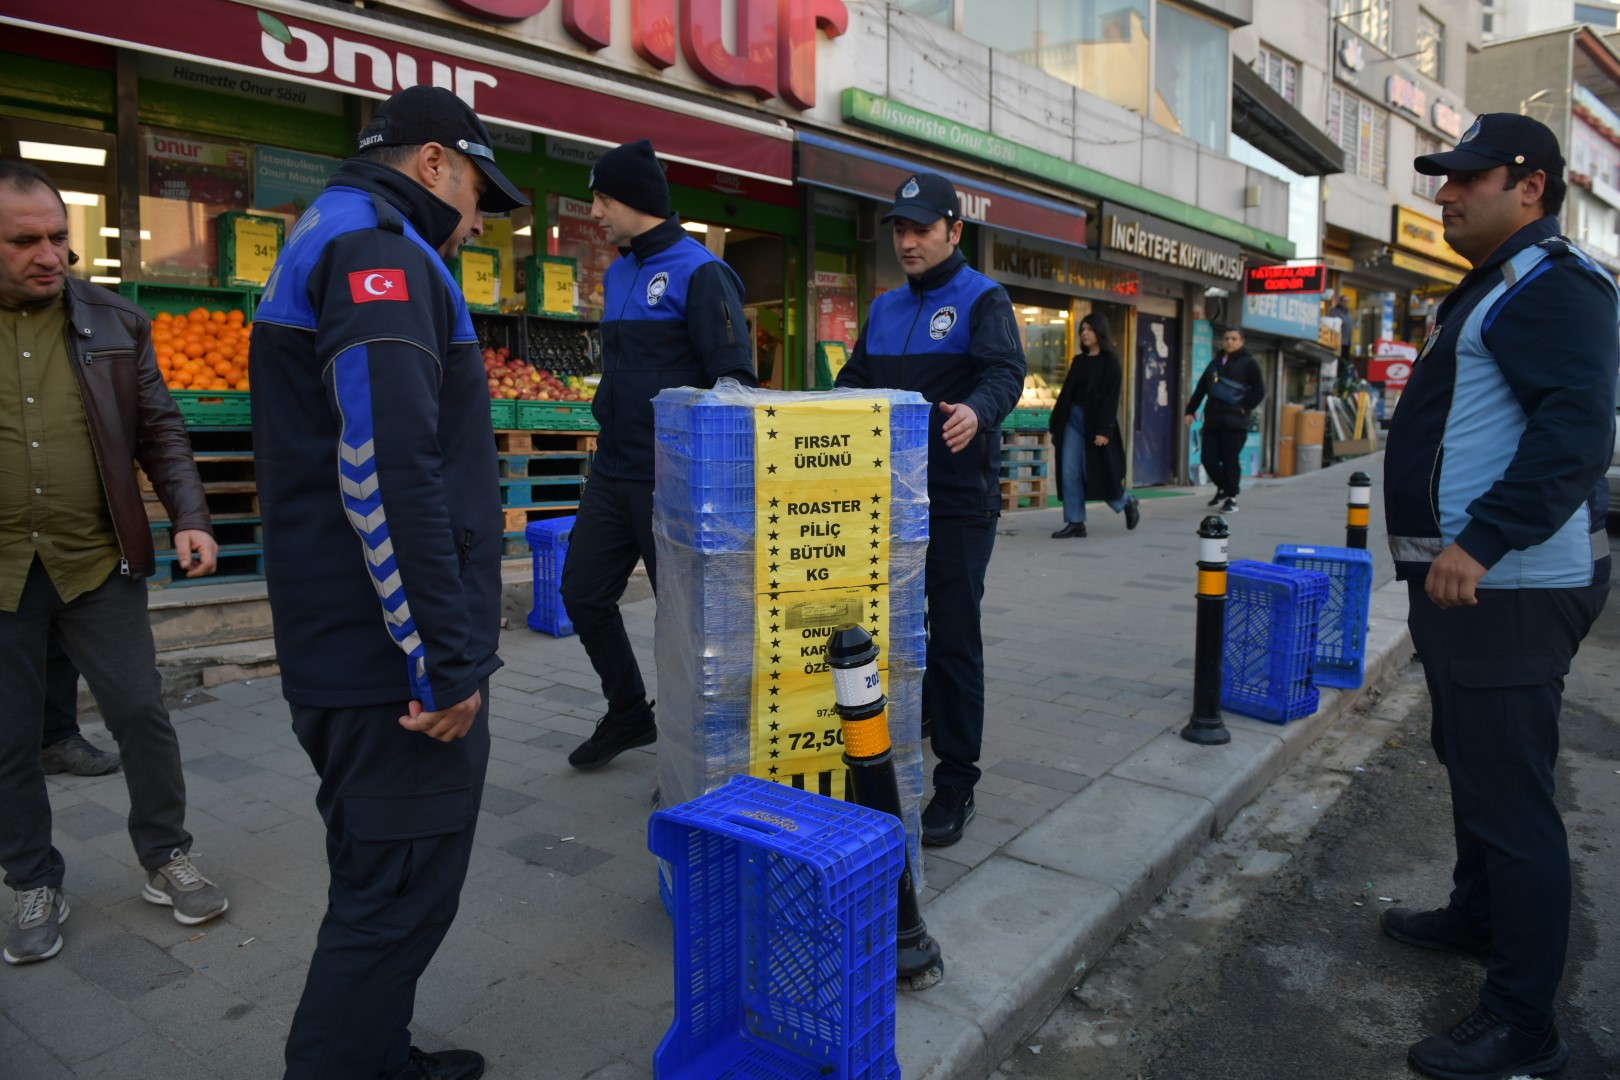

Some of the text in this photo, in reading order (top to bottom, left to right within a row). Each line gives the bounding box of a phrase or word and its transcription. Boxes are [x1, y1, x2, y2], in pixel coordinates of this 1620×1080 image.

[446, 0, 849, 111] nur
[173, 65, 307, 104] Hizmette Onur Sözü
[870, 97, 1017, 162] Alışverişte Onur Sözü
[154, 138, 203, 158] onur
[359, 133, 384, 150] ZABITA
[552, 143, 586, 161] Fiyatta
[259, 166, 287, 180] Onur
[955, 190, 992, 222] nur
[1110, 214, 1178, 265] İNCİRTEPE
[254, 244, 269, 257] 34
[476, 271, 487, 282] 34
[556, 281, 567, 292] 34
[794, 434, 851, 450] FIRSAT
[794, 451, 852, 469] ÜRÜNÜ
[787, 500, 861, 516] ROASTER
[800, 520, 841, 539] PİLİÇ
[790, 543, 846, 560] BÜTÜN
[806, 567, 830, 581] KG
[801, 626, 834, 639] ONU
[800, 644, 828, 657] KAR
[804, 662, 830, 675] ÖZE
[816, 708, 838, 718] 97,5
